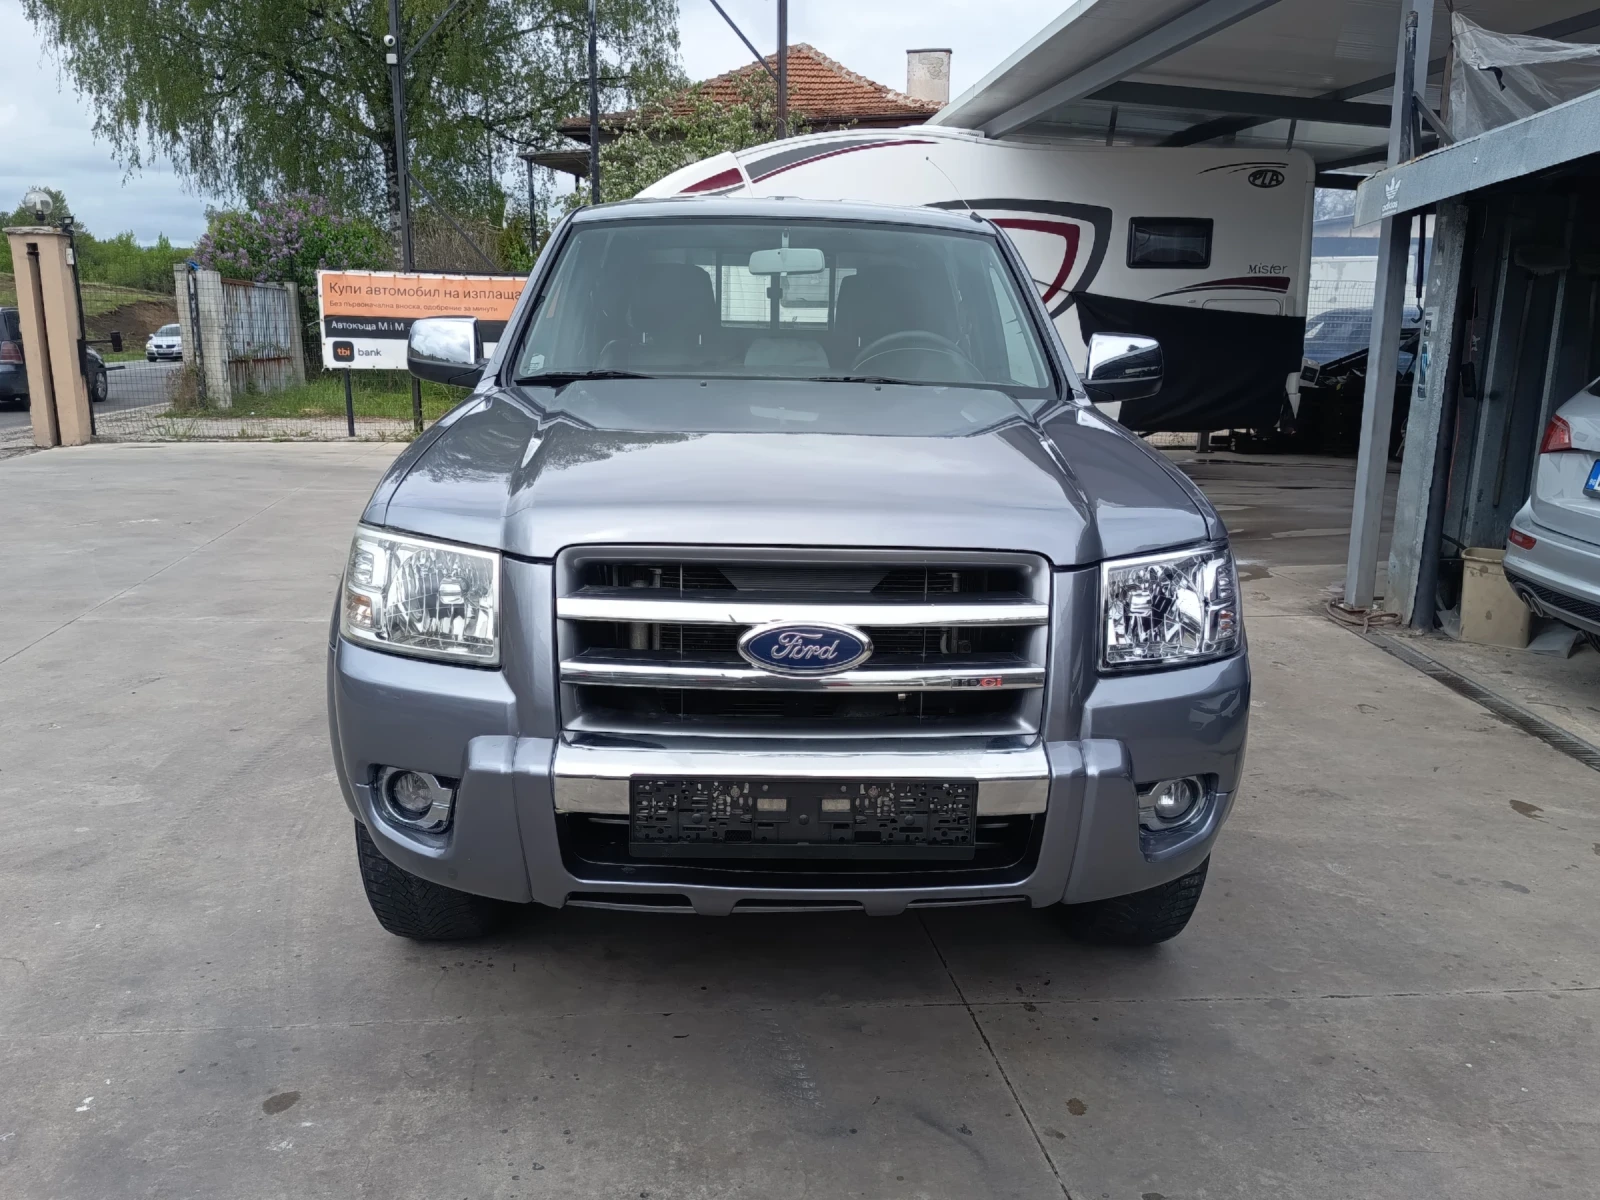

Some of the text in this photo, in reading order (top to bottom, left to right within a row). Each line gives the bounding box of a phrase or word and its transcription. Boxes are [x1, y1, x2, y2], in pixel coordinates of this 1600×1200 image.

[1250, 170, 1281, 186] PLA
[1381, 200, 1398, 212] adidas
[1247, 262, 1288, 275] Mister
[329, 282, 522, 301] Купи автомобил на изплаща
[343, 301, 394, 309] първоначална
[395, 303, 422, 311] вноска,
[423, 304, 462, 312] одобрение
[331, 320, 377, 331] Автокъща
[336, 347, 382, 357] tbi bank
[770, 631, 840, 660] Ford
